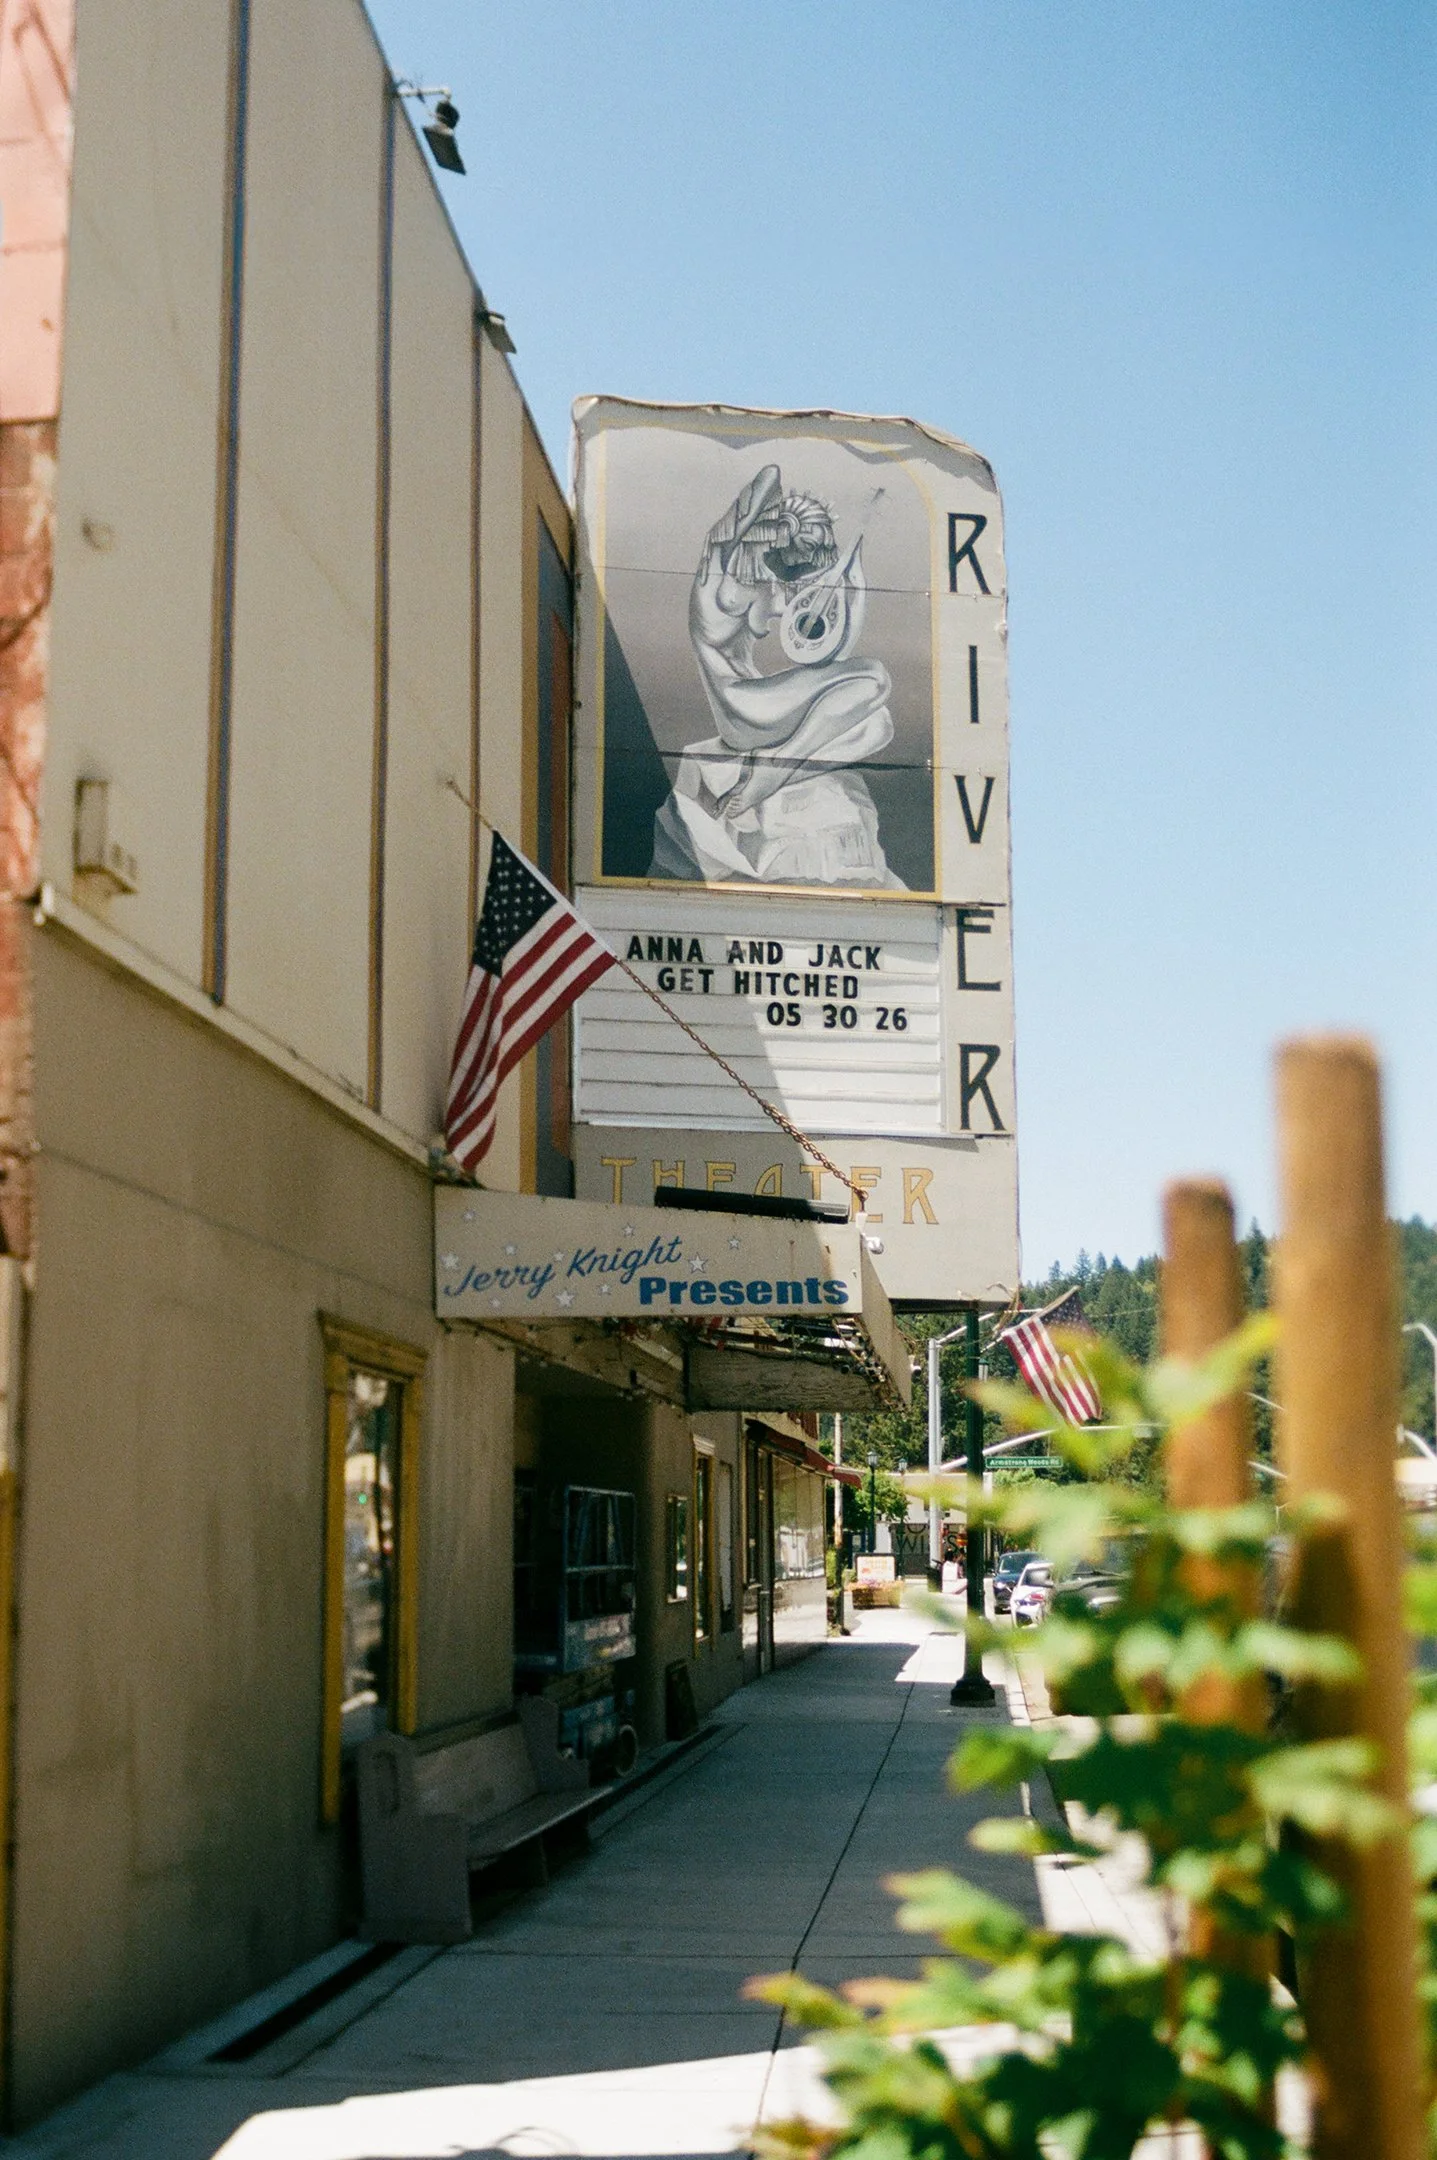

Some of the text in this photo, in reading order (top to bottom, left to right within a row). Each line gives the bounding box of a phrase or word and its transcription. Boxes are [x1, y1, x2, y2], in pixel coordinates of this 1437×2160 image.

[945, 512, 1007, 1132] RIVER
[627, 934, 882, 971] ANNA AND JACK
[657, 967, 859, 999] GET HITCHED
[766, 1001, 908, 1032] 05 30 26
[444, 1235, 684, 1300] Jerry Knight
[638, 1274, 850, 1306] Presents
[989, 1459, 1027, 1467] Armstrong
[1027, 1458, 1049, 1466] Woods
